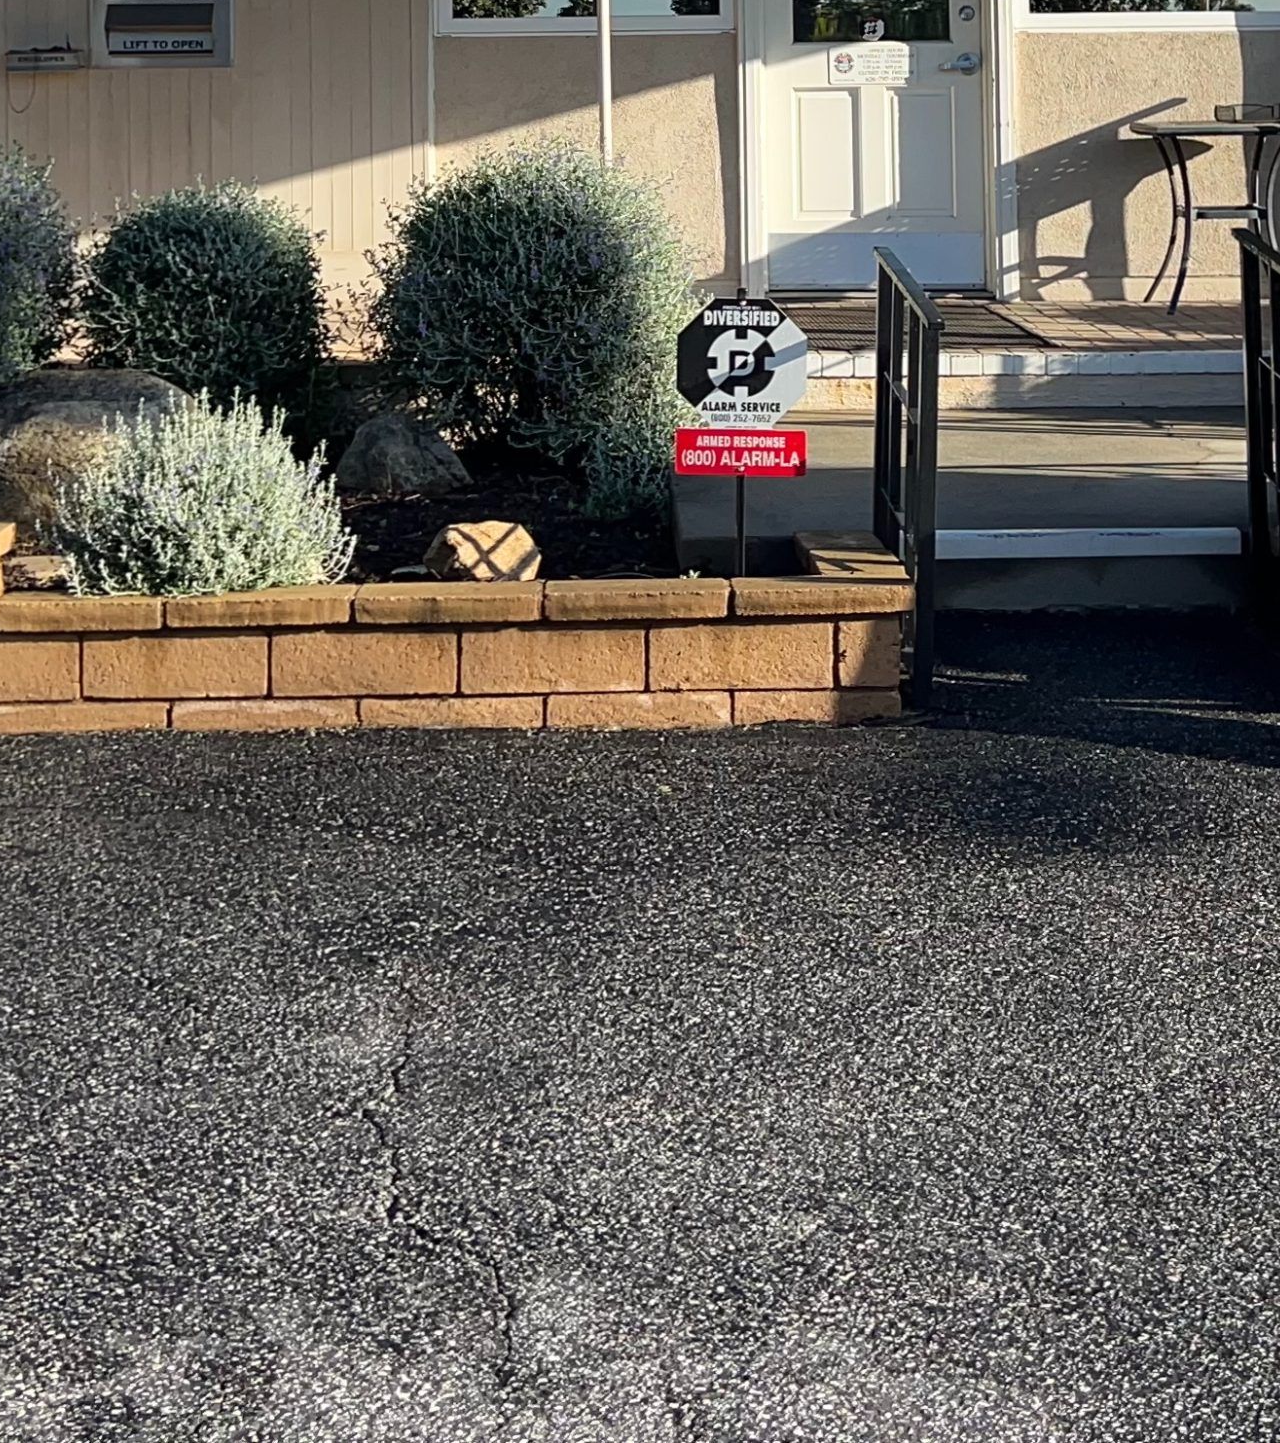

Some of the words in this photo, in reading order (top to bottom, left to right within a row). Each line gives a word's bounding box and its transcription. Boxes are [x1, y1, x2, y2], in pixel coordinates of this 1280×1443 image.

[123, 41, 150, 50] LIFT
[152, 41, 169, 50] TO
[172, 40, 204, 49] OPEN
[703, 310, 780, 326] DIVERSIFIED
[701, 402, 737, 412] ALARM
[740, 402, 780, 413] SERVICE
[696, 435, 730, 447] ARMED
[733, 436, 785, 448] RESPONSE
[681, 449, 716, 467] (800)
[720, 451, 800, 467] ALARM-LA
